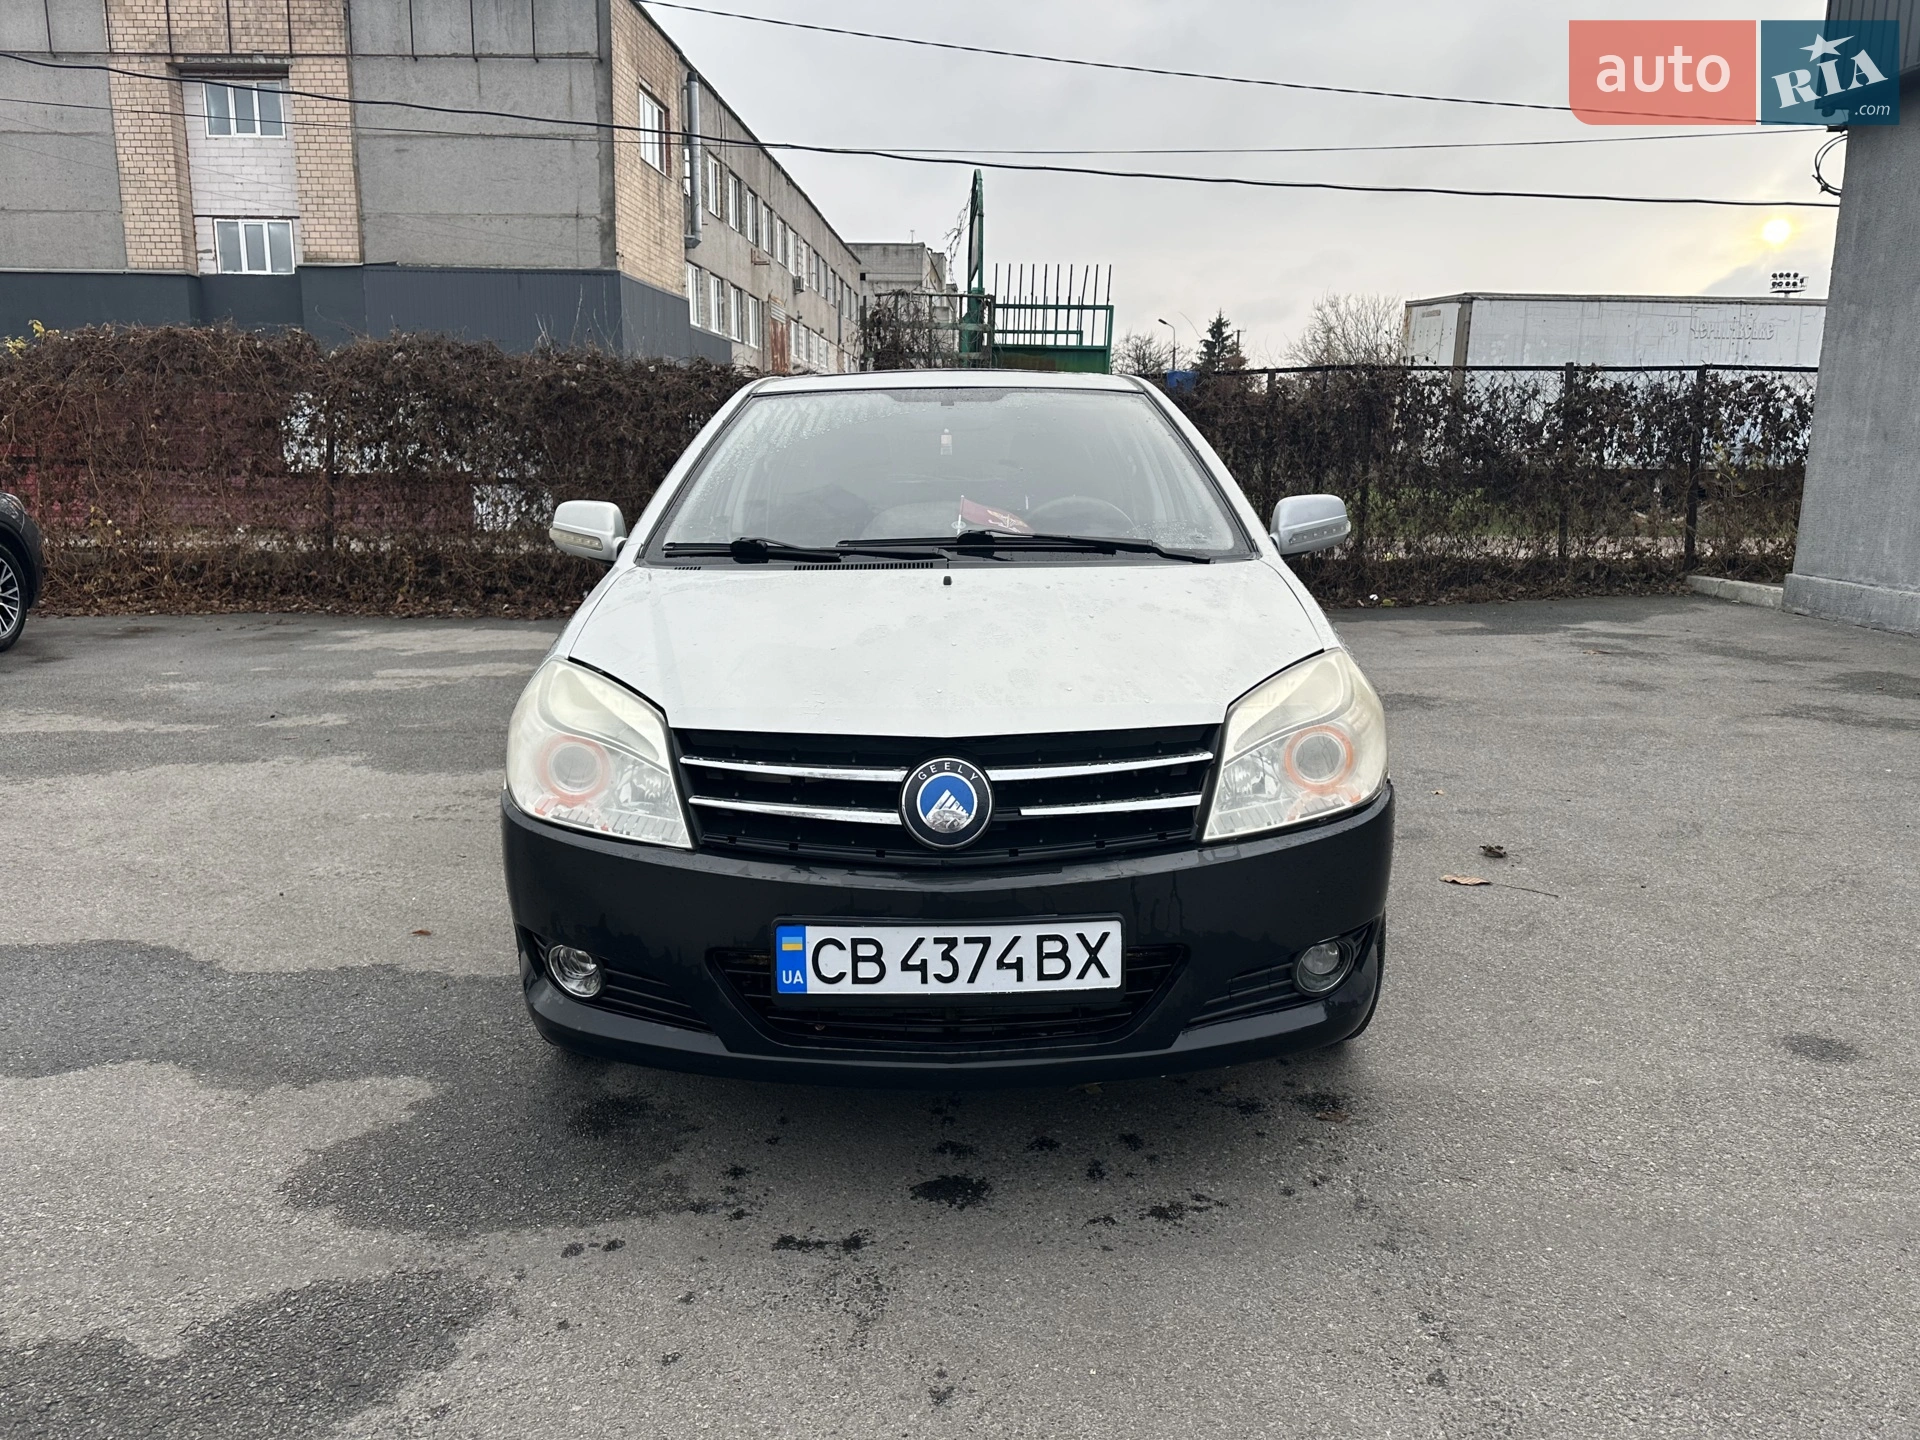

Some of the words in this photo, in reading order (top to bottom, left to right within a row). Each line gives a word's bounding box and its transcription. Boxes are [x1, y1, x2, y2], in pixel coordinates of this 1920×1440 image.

[917, 761, 979, 781] GEELY
[811, 937, 887, 985] CB
[900, 935, 1024, 985] 4374
[1036, 931, 1111, 982] BX
[782, 970, 804, 985] UA
